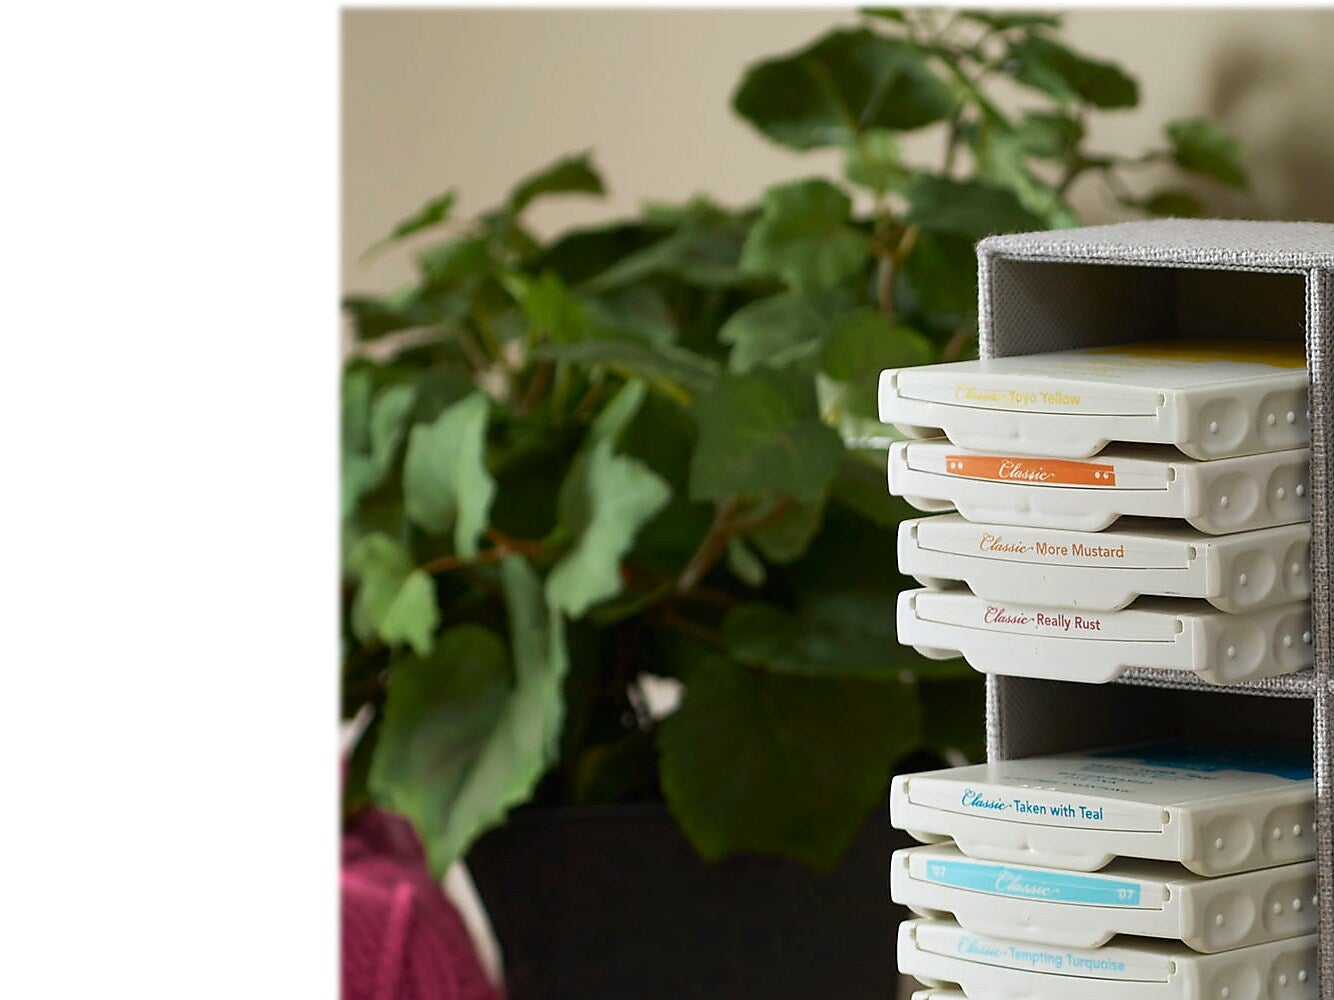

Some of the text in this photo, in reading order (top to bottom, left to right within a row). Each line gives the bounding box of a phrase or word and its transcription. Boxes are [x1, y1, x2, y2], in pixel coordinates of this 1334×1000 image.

[954, 382, 1081, 406] Classic Yoyo Yellow
[998, 459, 1055, 481] Classic
[979, 533, 1125, 559] Classic More Mustard
[983, 606, 1101, 632] Classic Really Rust
[961, 788, 1104, 821] Classic Taken with Teal
[995, 868, 1059, 897] Classic
[957, 935, 1126, 972] Classic Tempting Turquoise
